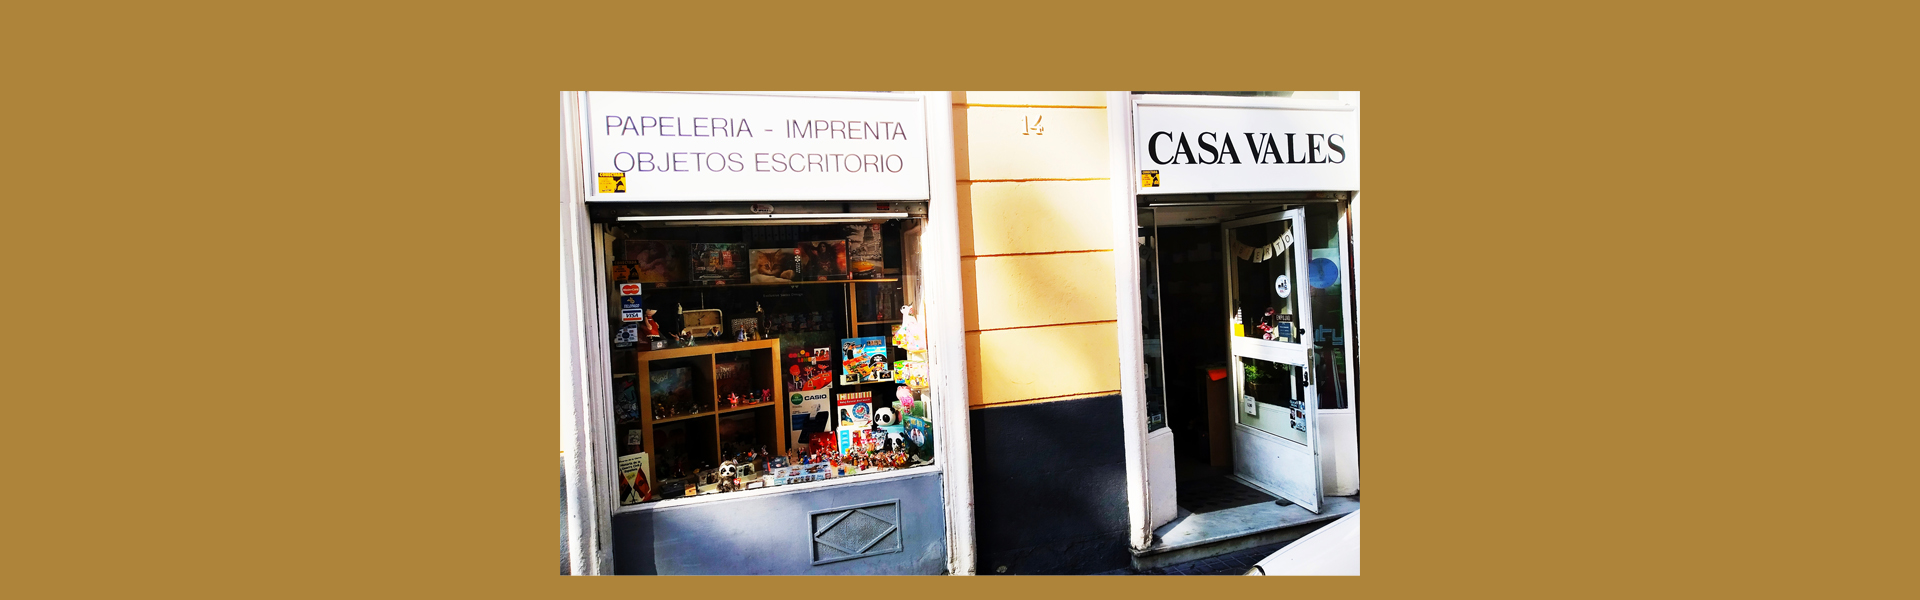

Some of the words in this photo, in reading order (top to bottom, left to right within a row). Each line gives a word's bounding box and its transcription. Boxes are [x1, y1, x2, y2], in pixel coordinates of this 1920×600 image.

[605, 115, 753, 138] PAPELERIA
[786, 119, 907, 140] IMPRENTA
[1021, 114, 1044, 136] 14
[1148, 131, 1242, 165] CASA
[1243, 132, 1346, 165] VALES
[613, 151, 744, 173] OBJETOS
[755, 152, 904, 173] ESCRITORIO
